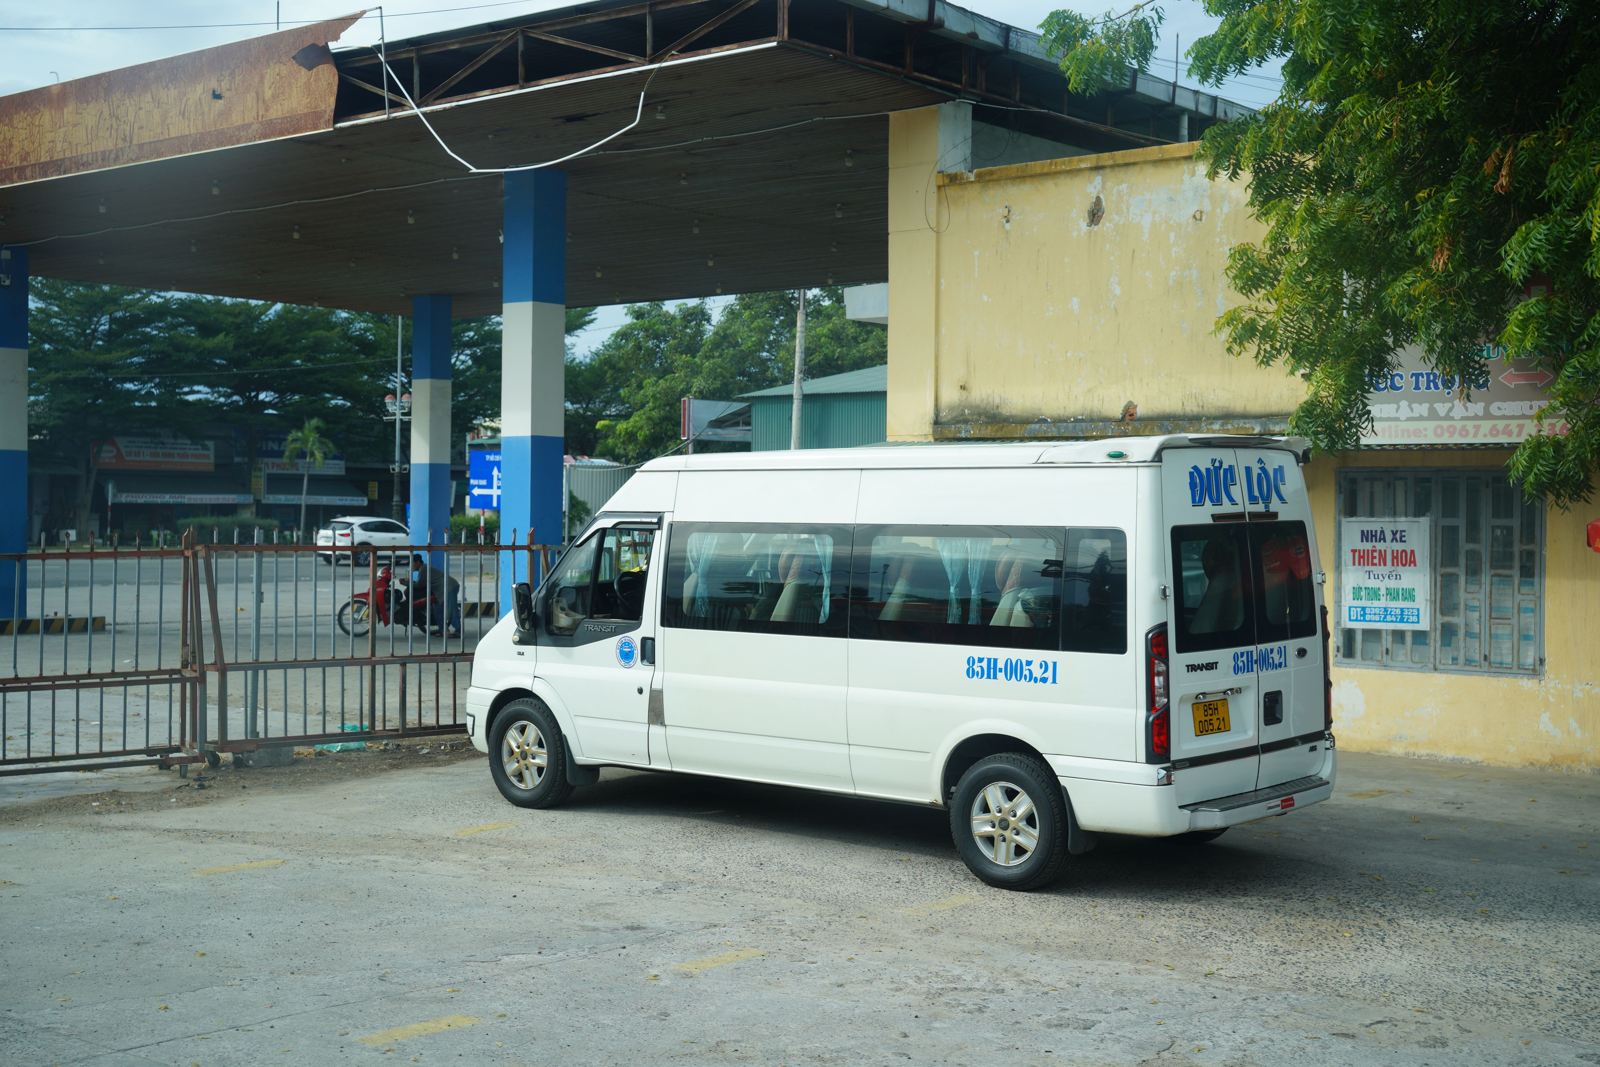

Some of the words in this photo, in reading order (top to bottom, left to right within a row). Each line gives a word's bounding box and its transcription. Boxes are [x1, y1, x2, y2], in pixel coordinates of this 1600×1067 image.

[1433, 399, 1485, 420] VẬN
[1189, 457, 1239, 507] ĐỨC
[1244, 457, 1289, 513] LỘC
[1360, 527, 1386, 543] NHÀ
[1390, 529, 1407, 543] XE
[1350, 545, 1387, 567] THIÊN
[1391, 549, 1417, 567] HOA
[1365, 569, 1402, 582] Tuyến
[1385, 587, 1400, 603] PHAN
[584, 624, 616, 632] TRANSIT
[1185, 661, 1219, 673] TRANSIT
[1233, 645, 1288, 675] 85H-005.21
[966, 655, 1058, 685] 85H-005.21
[1203, 702, 1219, 717] 85H
[1198, 717, 1227, 734] 005.21
